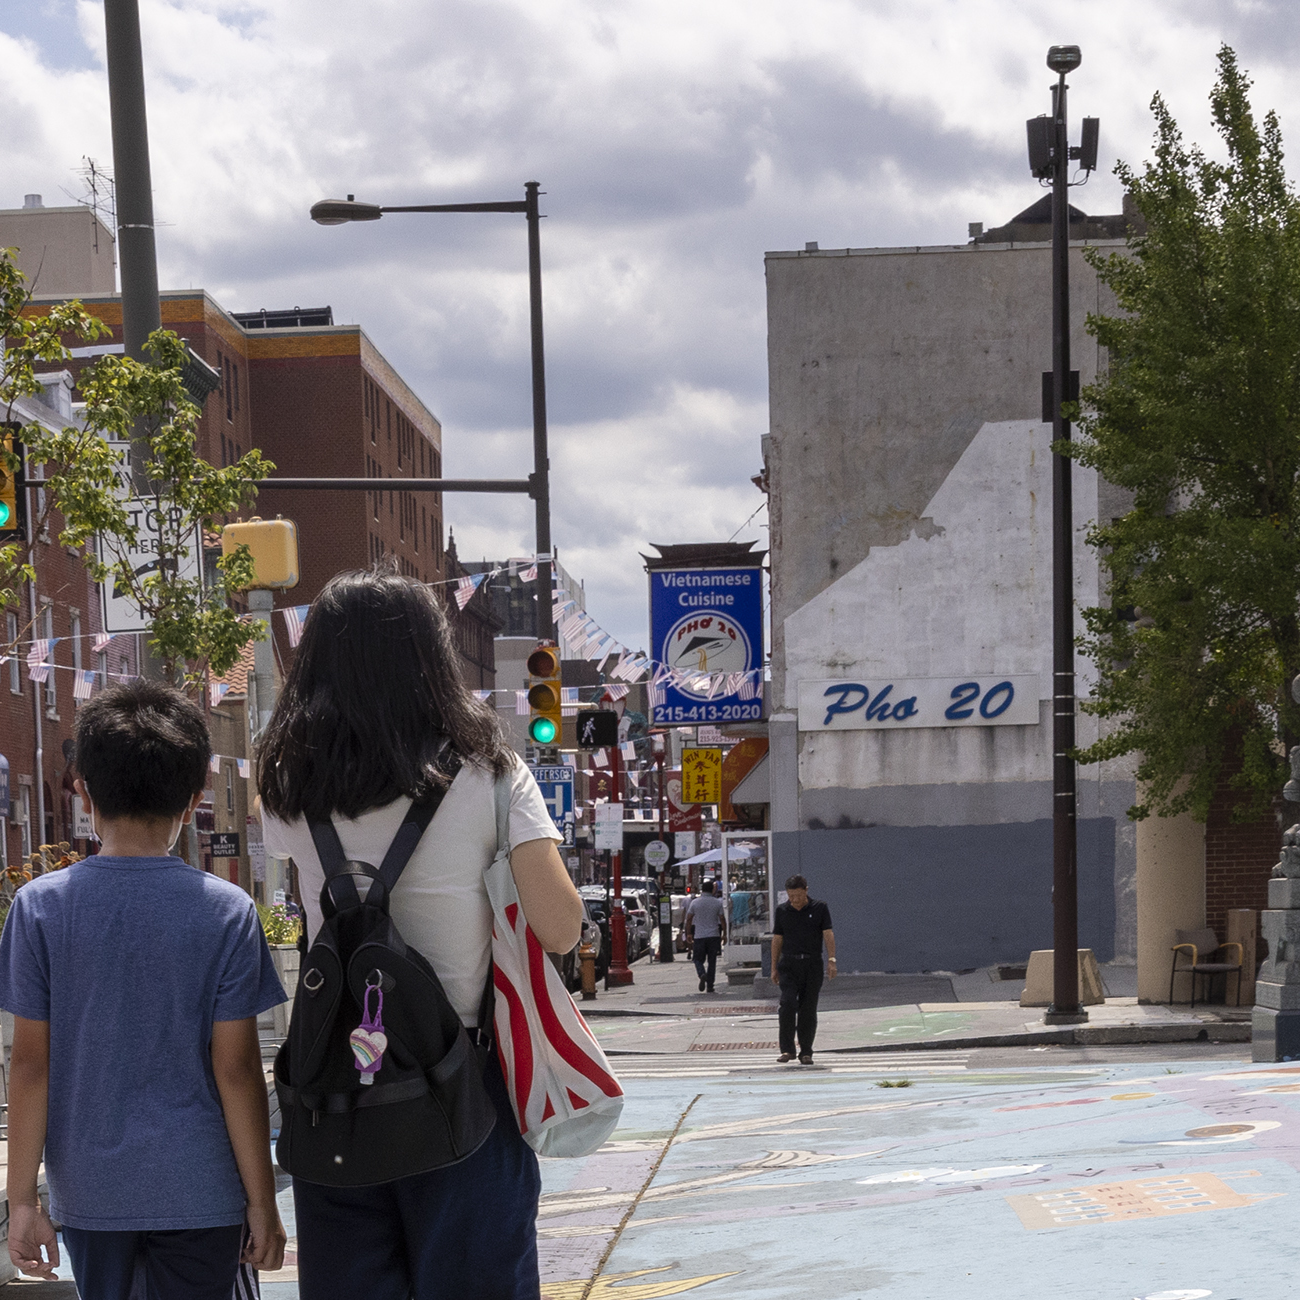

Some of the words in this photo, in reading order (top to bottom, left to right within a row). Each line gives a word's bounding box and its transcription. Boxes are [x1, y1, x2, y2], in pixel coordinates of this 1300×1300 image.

[129, 507, 183, 533] TOP
[128, 538, 171, 555] HER
[661, 573, 751, 588] Vietnamese
[678, 592, 735, 606] Cuisine
[718, 621, 737, 641] 20
[944, 681, 1015, 720] 20
[655, 704, 761, 721] 215-413-2020
[684, 750, 700, 765] WIN
[704, 751, 721, 766] FAR
[530, 769, 570, 780] EFFERSO
[220, 835, 228, 844] K
